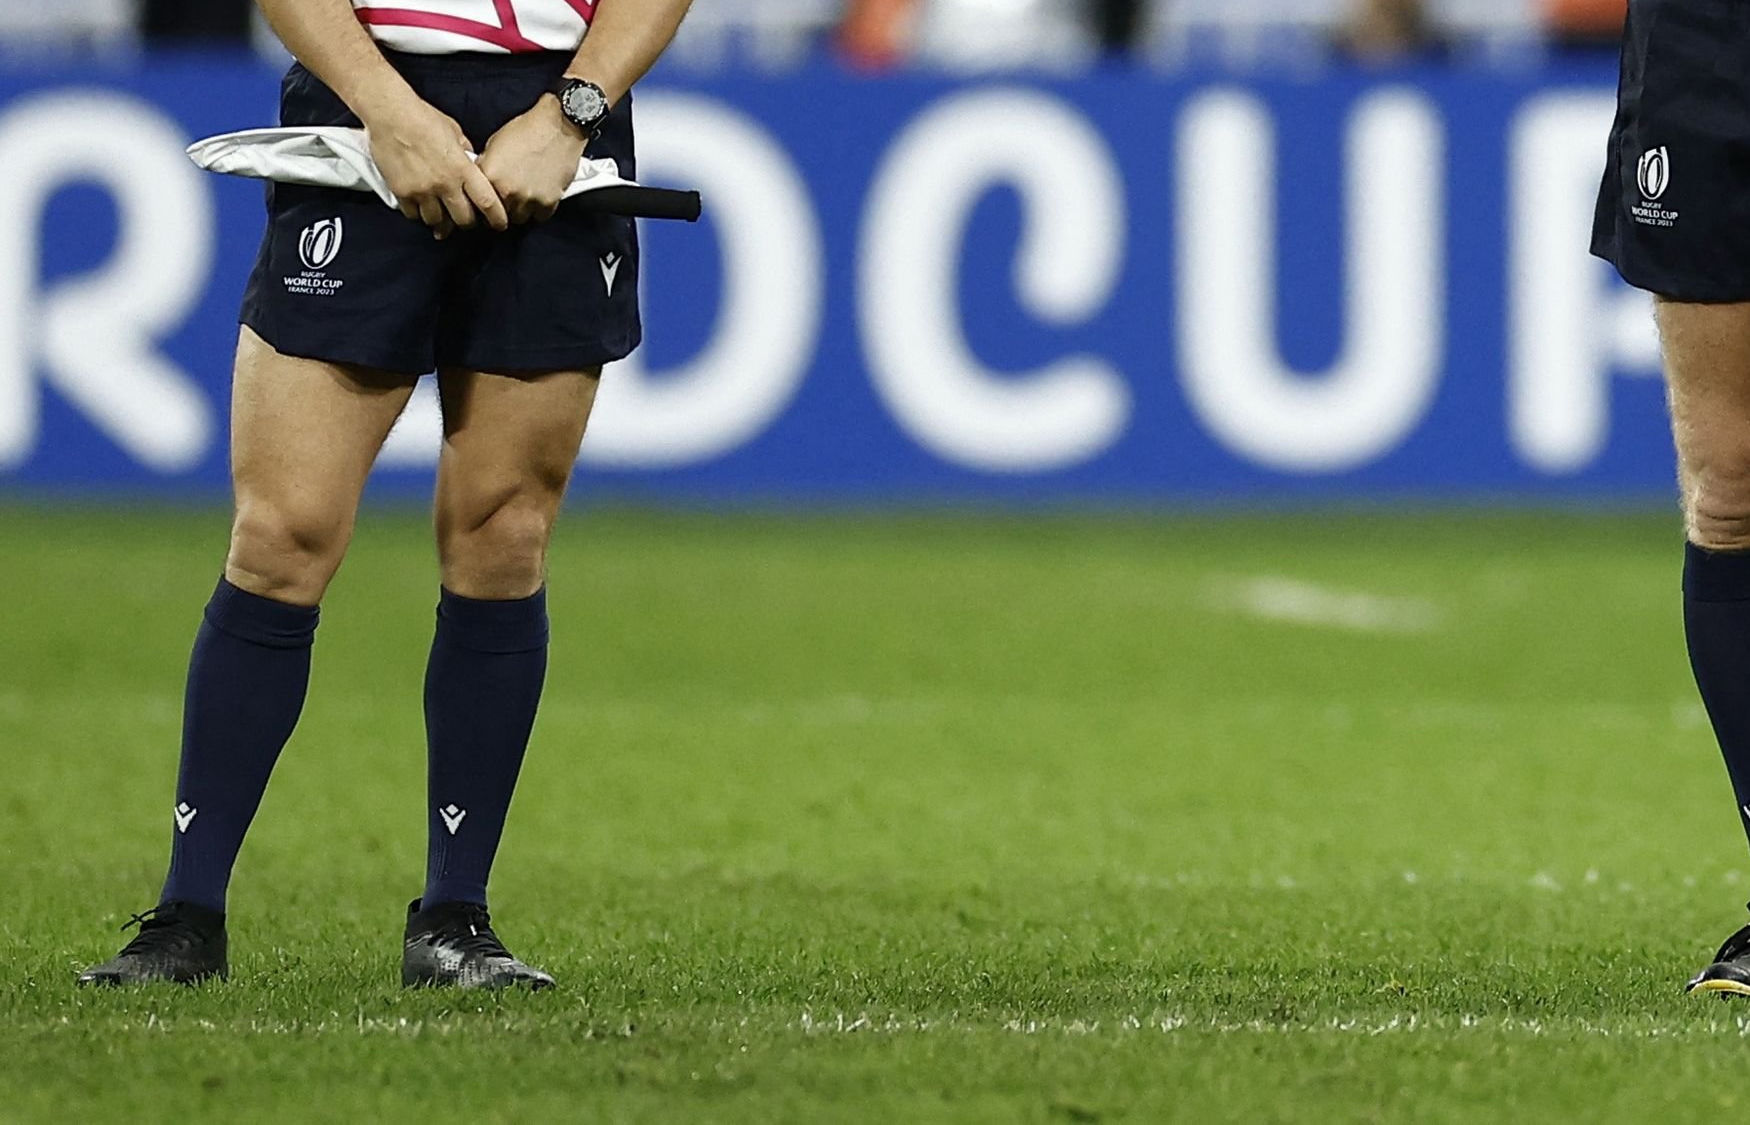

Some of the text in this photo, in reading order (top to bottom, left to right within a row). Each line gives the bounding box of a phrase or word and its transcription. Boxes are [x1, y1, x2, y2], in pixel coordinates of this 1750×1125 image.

[1631, 206, 1679, 220] WORLD CUP
[284, 277, 343, 288] WORLD CUP
[288, 286, 314, 294] FRANCE
